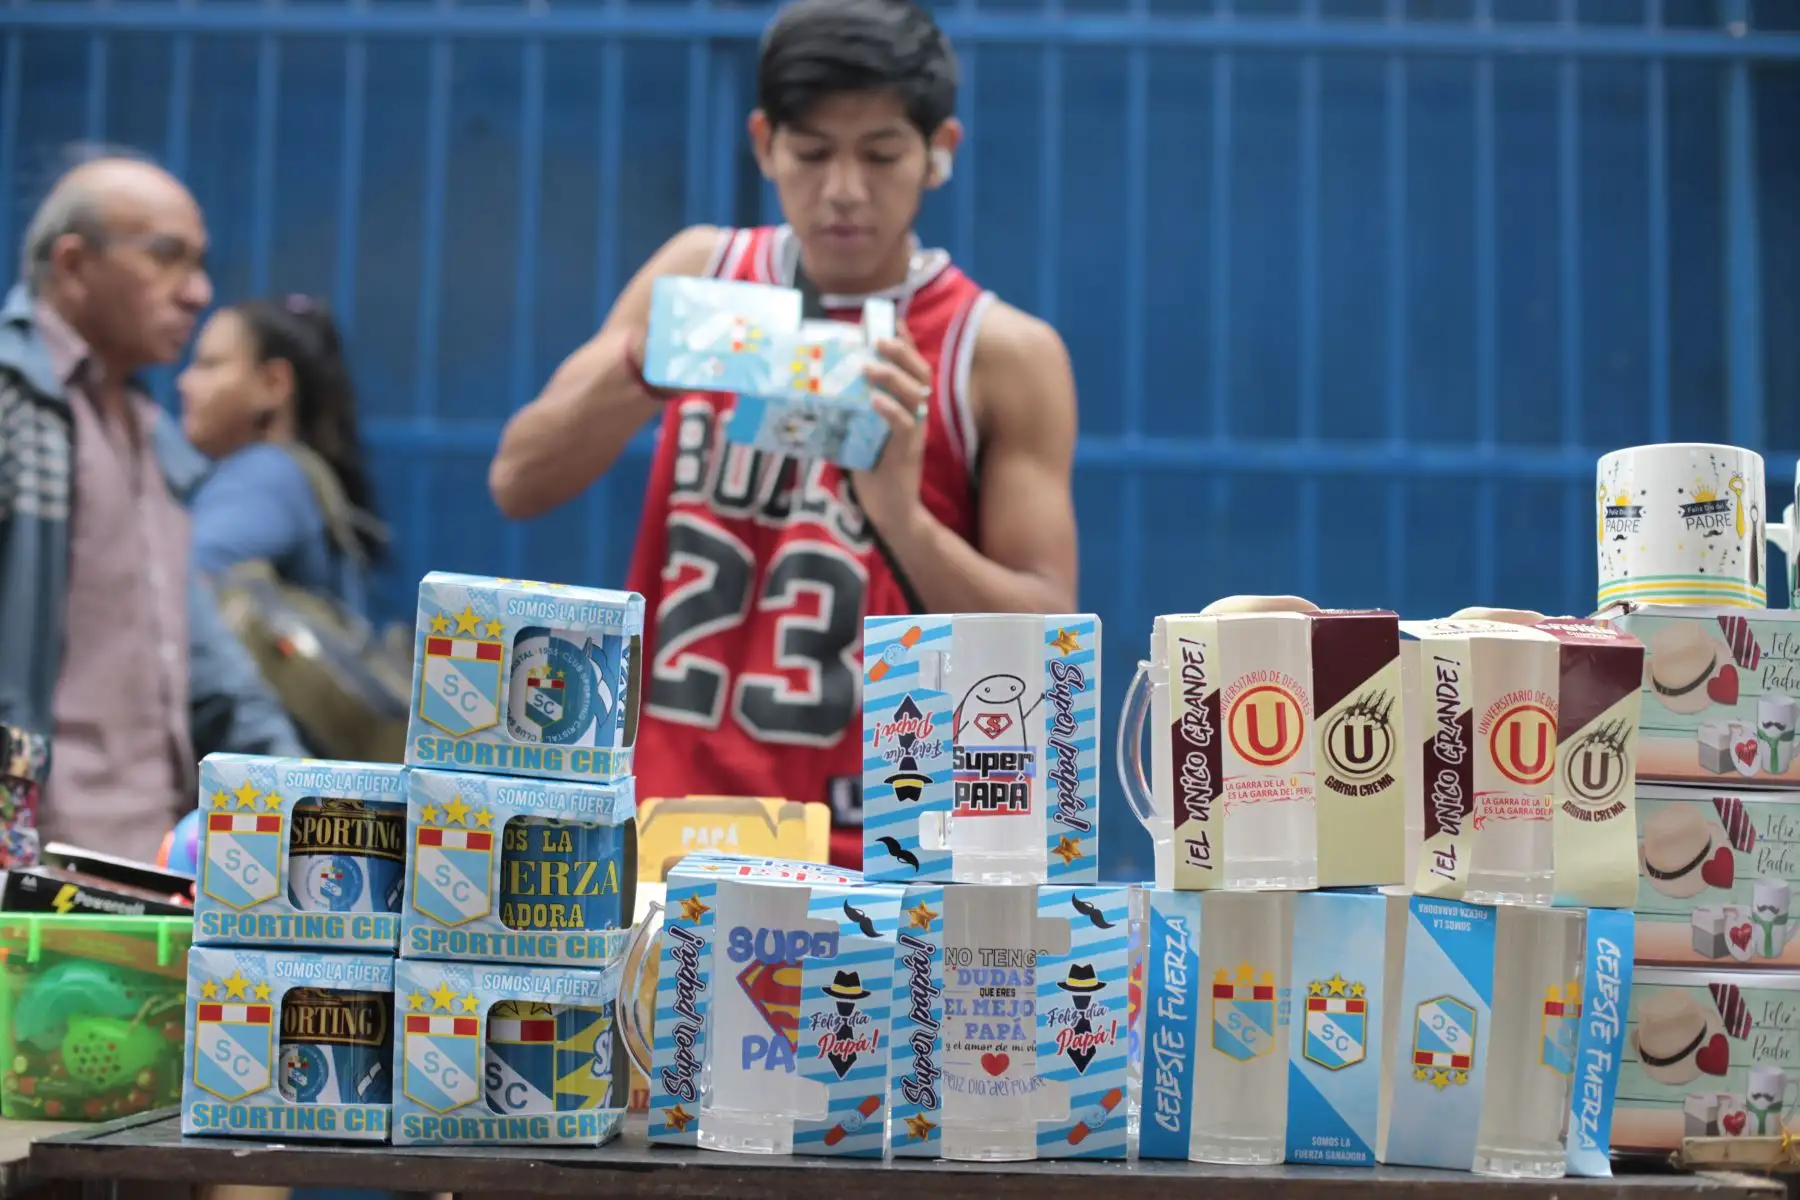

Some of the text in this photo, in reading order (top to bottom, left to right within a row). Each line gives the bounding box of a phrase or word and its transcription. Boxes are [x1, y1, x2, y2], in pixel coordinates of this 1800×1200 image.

[1606, 519, 1640, 533] PADRE
[1686, 513, 1732, 530] PADRE
[508, 599, 554, 619] SOMOS
[559, 603, 575, 621] LA
[644, 510, 869, 747] 23
[1269, 670, 1281, 682] DE
[443, 674, 480, 713] SC
[534, 693, 555, 715] SC
[1178, 637, 1214, 747] GRANDE!
[1433, 655, 1466, 765] GRANDE!
[1478, 689, 1533, 736] UNIVERSITARIO
[873, 711, 934, 748] Papá!
[1245, 702, 1288, 756] U
[416, 735, 563, 770] SPORTING
[1047, 659, 1091, 832] Super papá!
[1344, 724, 1374, 765] U
[1509, 721, 1547, 775] U
[953, 746, 1034, 778] Super
[1582, 751, 1610, 791] U
[286, 771, 332, 789] SOMOS
[336, 773, 351, 790] LA
[954, 775, 1028, 810] PAPÁ
[1236, 781, 1262, 790] GARRA
[1263, 780, 1274, 788] DE
[1238, 791, 1248, 799] LA
[1250, 789, 1279, 798] GARRA
[1280, 788, 1294, 796] DEL
[1324, 773, 1395, 797] GARRA CREMA
[497, 788, 614, 815] SOMOS LA FUERZ
[1482, 797, 1491, 805] LA
[1493, 798, 1519, 806] GARRA
[1521, 798, 1531, 806] DE
[1484, 806, 1493, 814] ES
[1507, 807, 1534, 815] GARRA
[1561, 800, 1626, 822] GARRA CREMA
[291, 816, 400, 849] SPORTING
[503, 829, 573, 852] OS LA
[224, 849, 260, 885] SC
[435, 865, 470, 902] SC
[201, 911, 344, 939] SPORTING
[502, 903, 584, 929] ADORA
[1433, 918, 1472, 932] SOMOS LA
[1460, 907, 1488, 920] FUERZA
[411, 926, 557, 958] SPORTING
[275, 960, 391, 983] SOMOS LA FUERZ
[945, 947, 1044, 968] NO TENG
[483, 973, 530, 992] SOMOS
[535, 976, 551, 994] LA
[957, 968, 1035, 987] DUDAS
[944, 998, 1036, 1017] EL MEJO
[979, 988, 1016, 998] QUE ERES
[284, 1005, 373, 1036] ORTING
[661, 925, 706, 1102] Super papá!
[811, 1012, 842, 1032] Feliz
[900, 934, 942, 1110] Super papá!
[1047, 1007, 1083, 1028] Feliz
[1152, 915, 1188, 1133] CELESTE FUERZA
[1227, 1011, 1257, 1044] SC
[965, 1017, 1027, 1040] PAPÁ
[1056, 1020, 1117, 1056] Papá!
[1321, 1023, 1349, 1052] SC
[1432, 1014, 1460, 1043] SC
[1579, 936, 1622, 1150] CELESTE FUERZA
[215, 1039, 250, 1076] SC
[742, 1034, 797, 1074] PA
[817, 1028, 880, 1060] Papá!
[953, 1041, 961, 1050] el
[995, 1042, 1008, 1052] de
[1012, 1044, 1024, 1052] mi
[423, 1051, 459, 1090] SC
[485, 1062, 528, 1110] SC
[192, 1103, 386, 1132] SPORTING CR
[403, 1114, 549, 1141] SPORTING
[1295, 1149, 1366, 1161] FUERZA GANADORA
[1311, 1135, 1351, 1148] SOMOS LA
